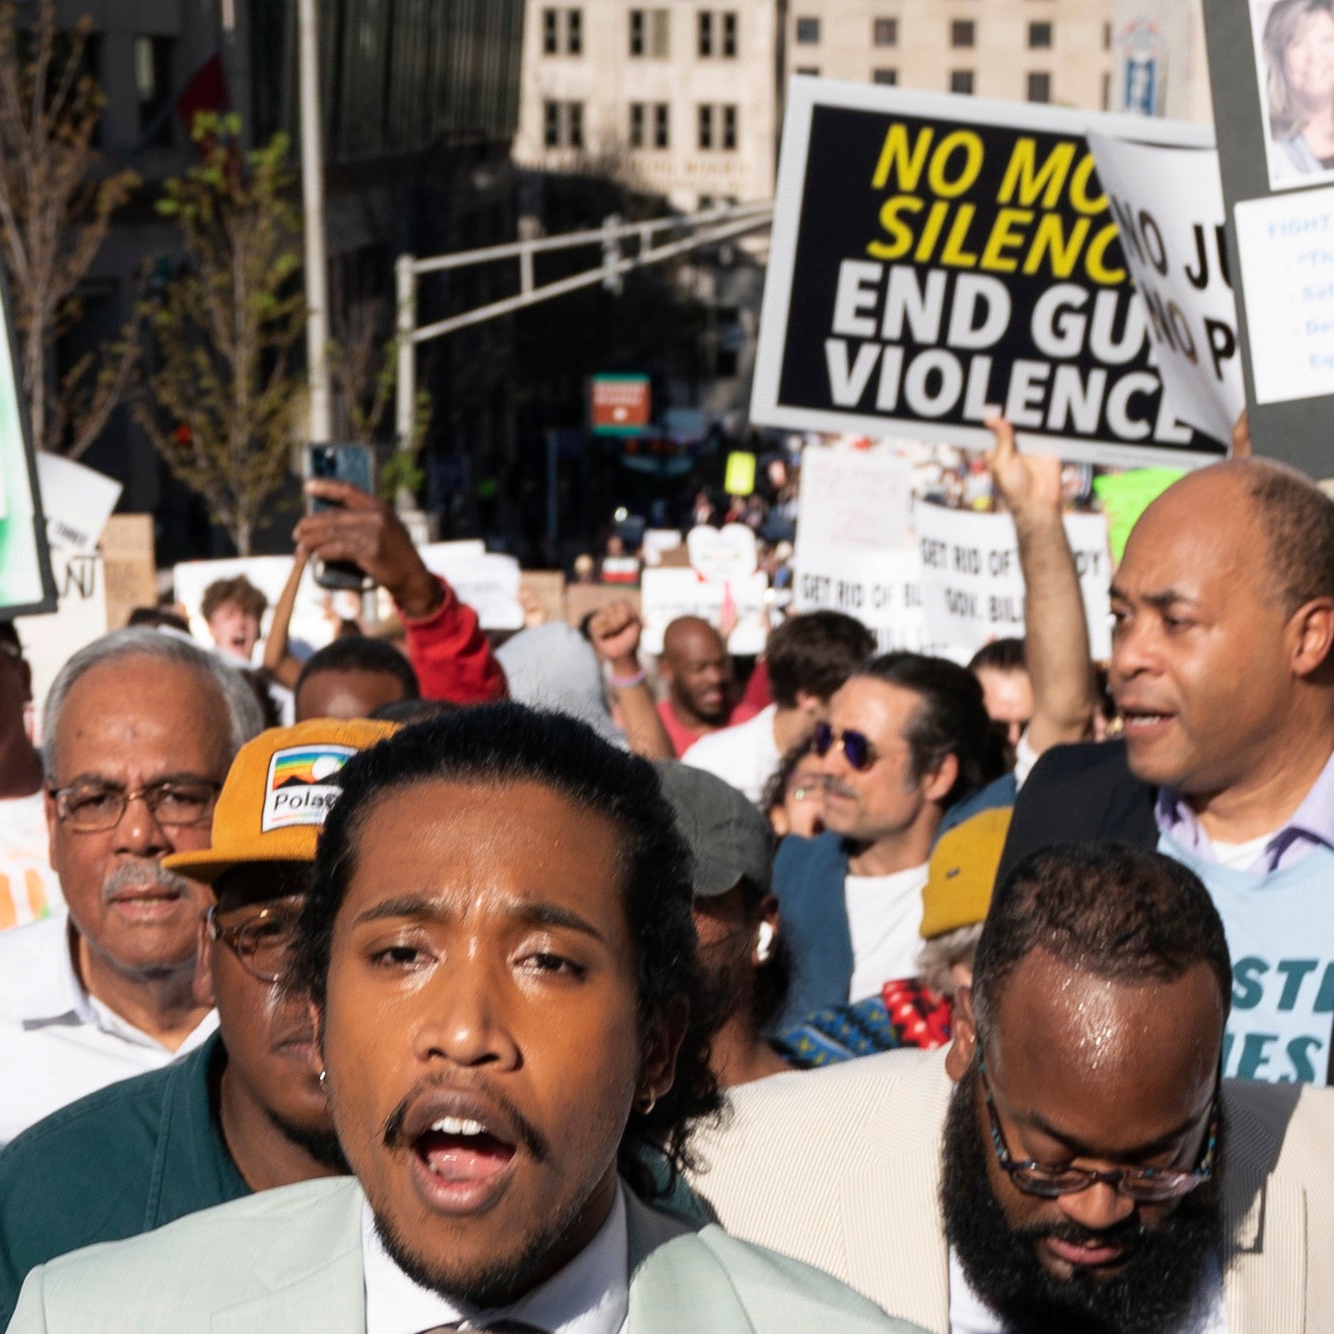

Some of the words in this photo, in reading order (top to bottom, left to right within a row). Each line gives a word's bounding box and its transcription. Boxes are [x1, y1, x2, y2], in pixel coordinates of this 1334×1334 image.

[871, 123, 985, 199] NO
[866, 196, 1136, 284] SILENC
[1268, 213, 1331, 239] FIGHT
[831, 259, 1012, 350] END
[1030, 284, 1159, 365] GU
[1222, 1032, 1323, 1083] ES
